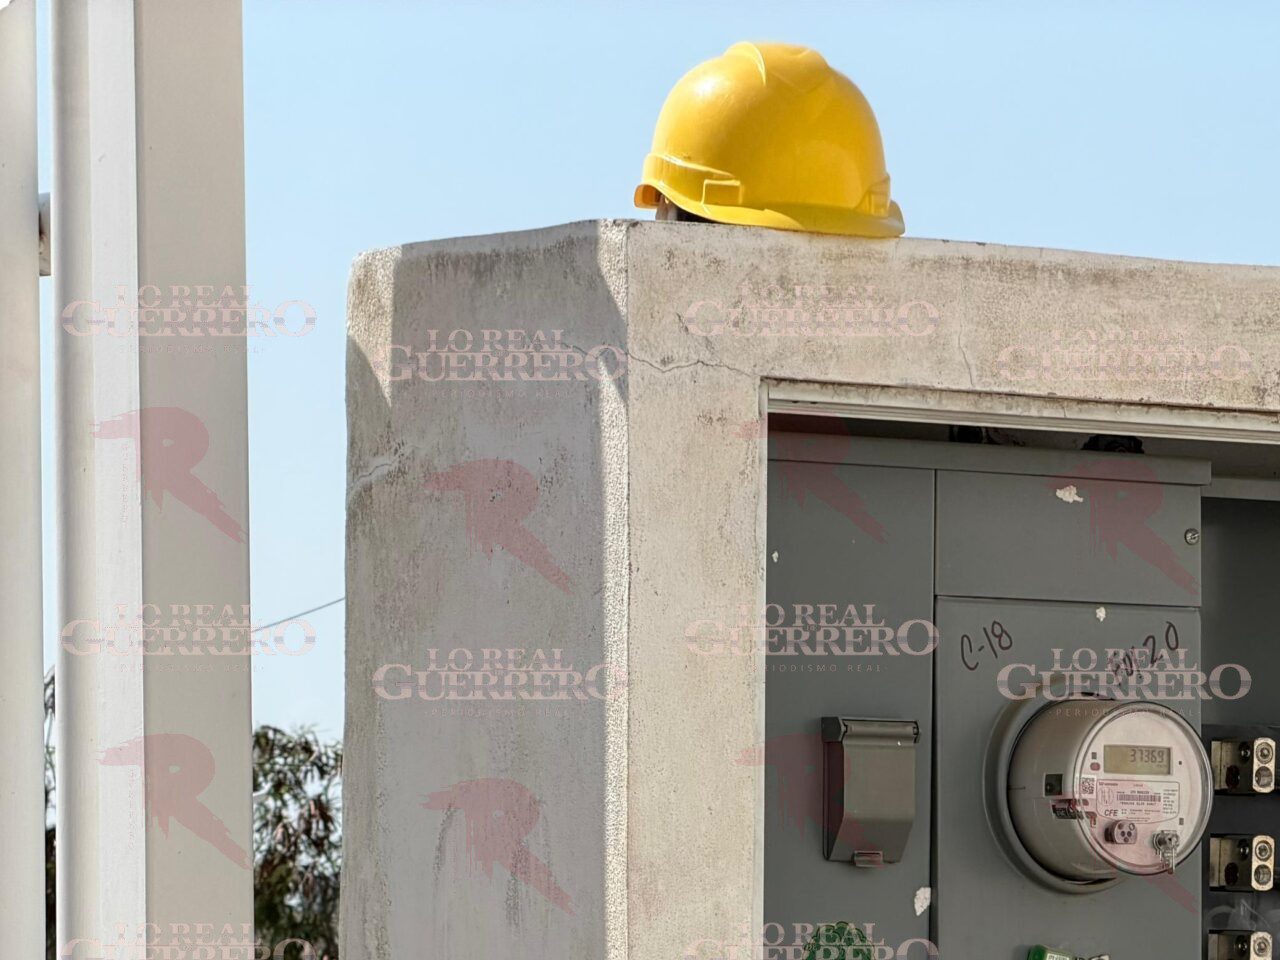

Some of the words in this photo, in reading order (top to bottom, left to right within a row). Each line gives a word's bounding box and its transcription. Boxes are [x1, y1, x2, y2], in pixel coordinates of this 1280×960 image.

[960, 620, 1013, 671] C-18
[1129, 748, 1165, 763] 37369
[1104, 809, 1119, 817] CFE
